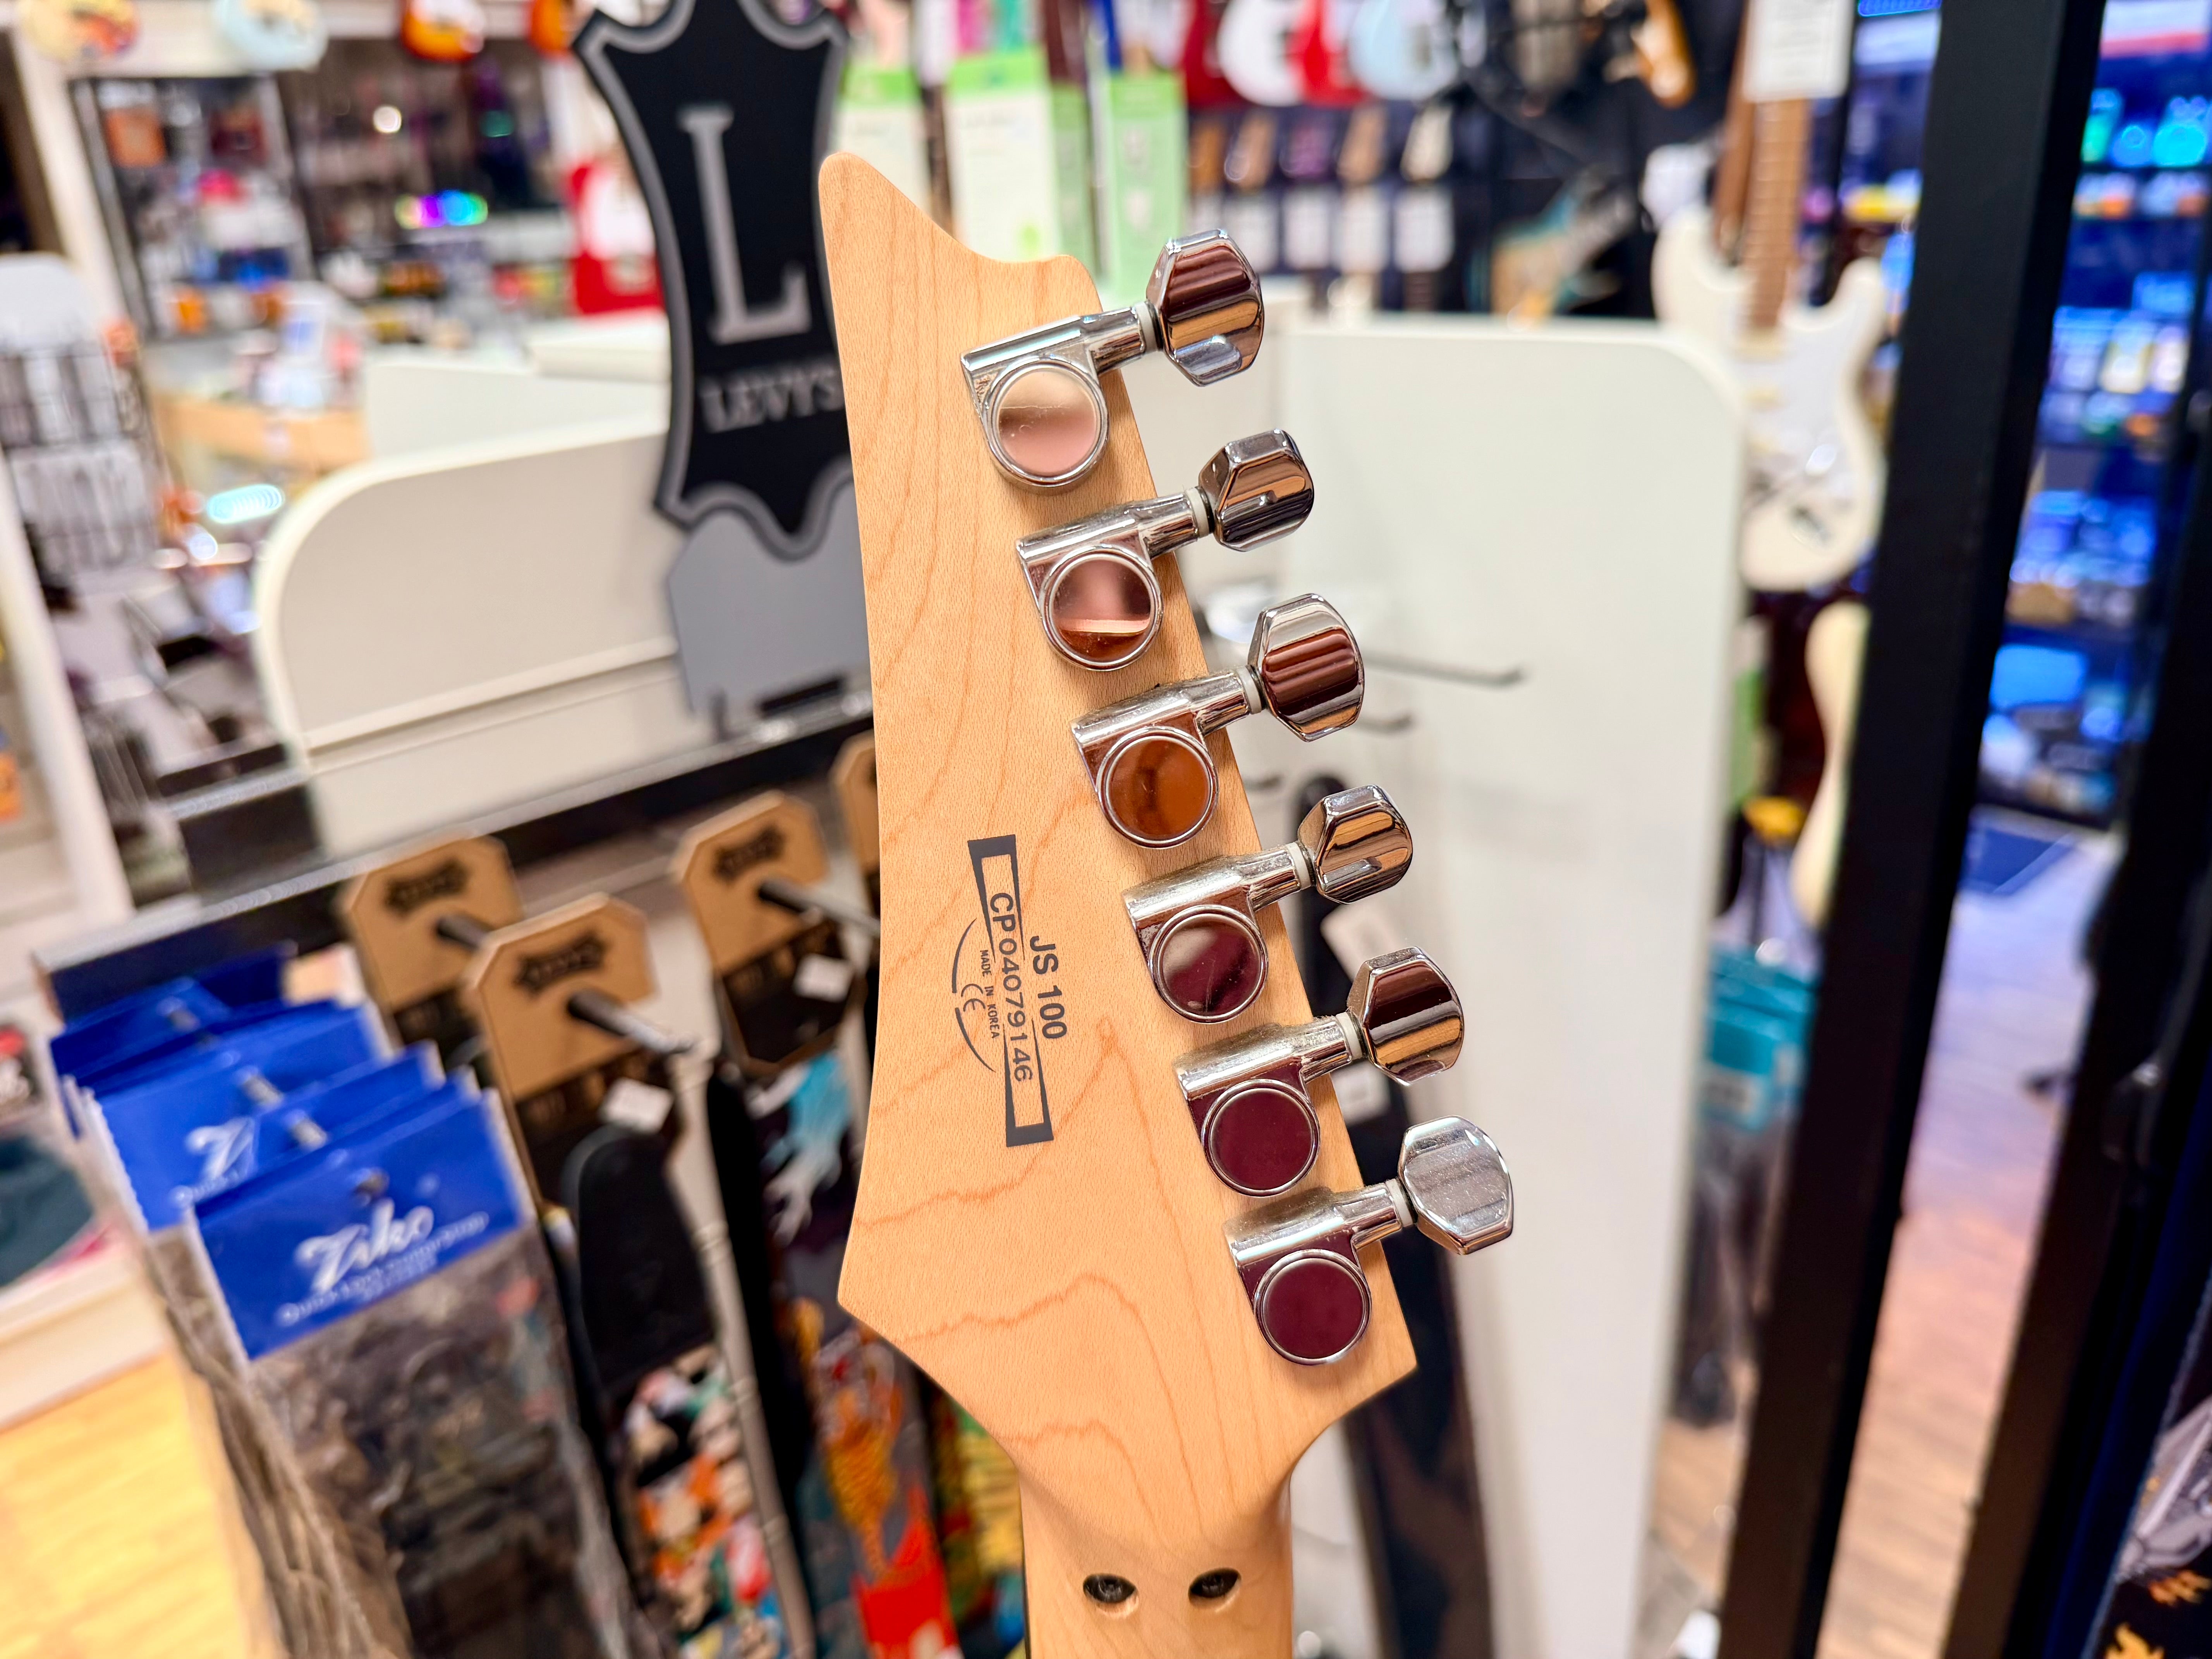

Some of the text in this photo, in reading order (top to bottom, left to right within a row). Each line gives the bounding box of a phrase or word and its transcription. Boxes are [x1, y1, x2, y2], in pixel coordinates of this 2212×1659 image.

[677, 105, 812, 345] L
[961, 983, 986, 1012] CE
[980, 949, 1000, 1038] MADE IN KOREA
[1029, 935, 1067, 1039] JS 100
[294, 1198, 434, 1291] Ziko
